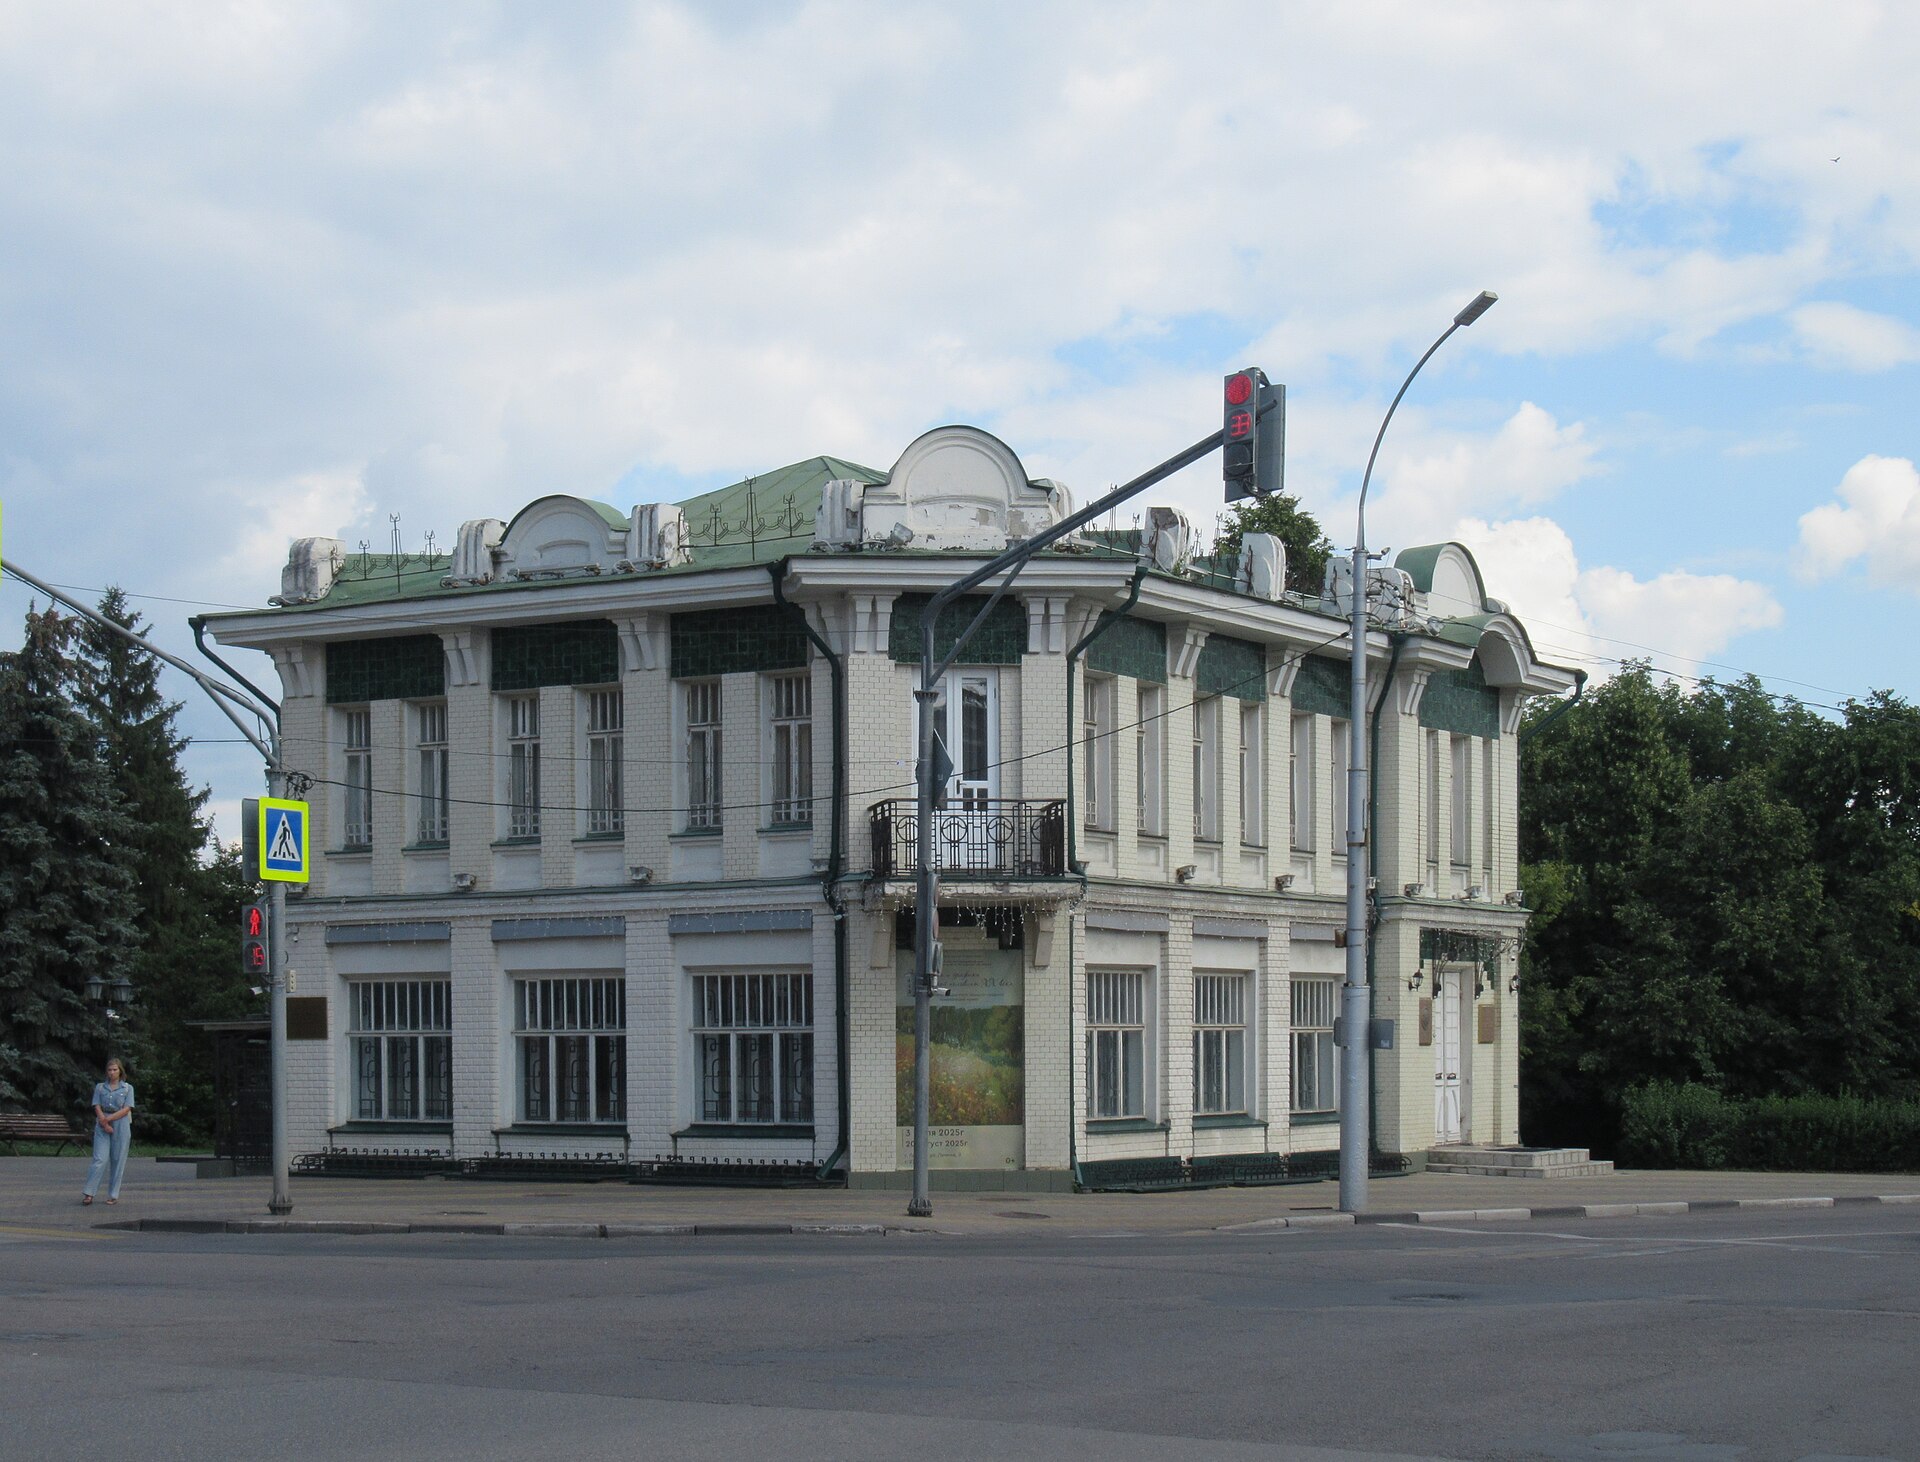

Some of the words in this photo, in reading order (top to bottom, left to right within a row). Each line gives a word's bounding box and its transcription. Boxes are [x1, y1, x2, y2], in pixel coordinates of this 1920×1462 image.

[252, 946, 265, 965] 15
[905, 1129, 911, 1137] 3
[938, 1129, 965, 1137] 2025г
